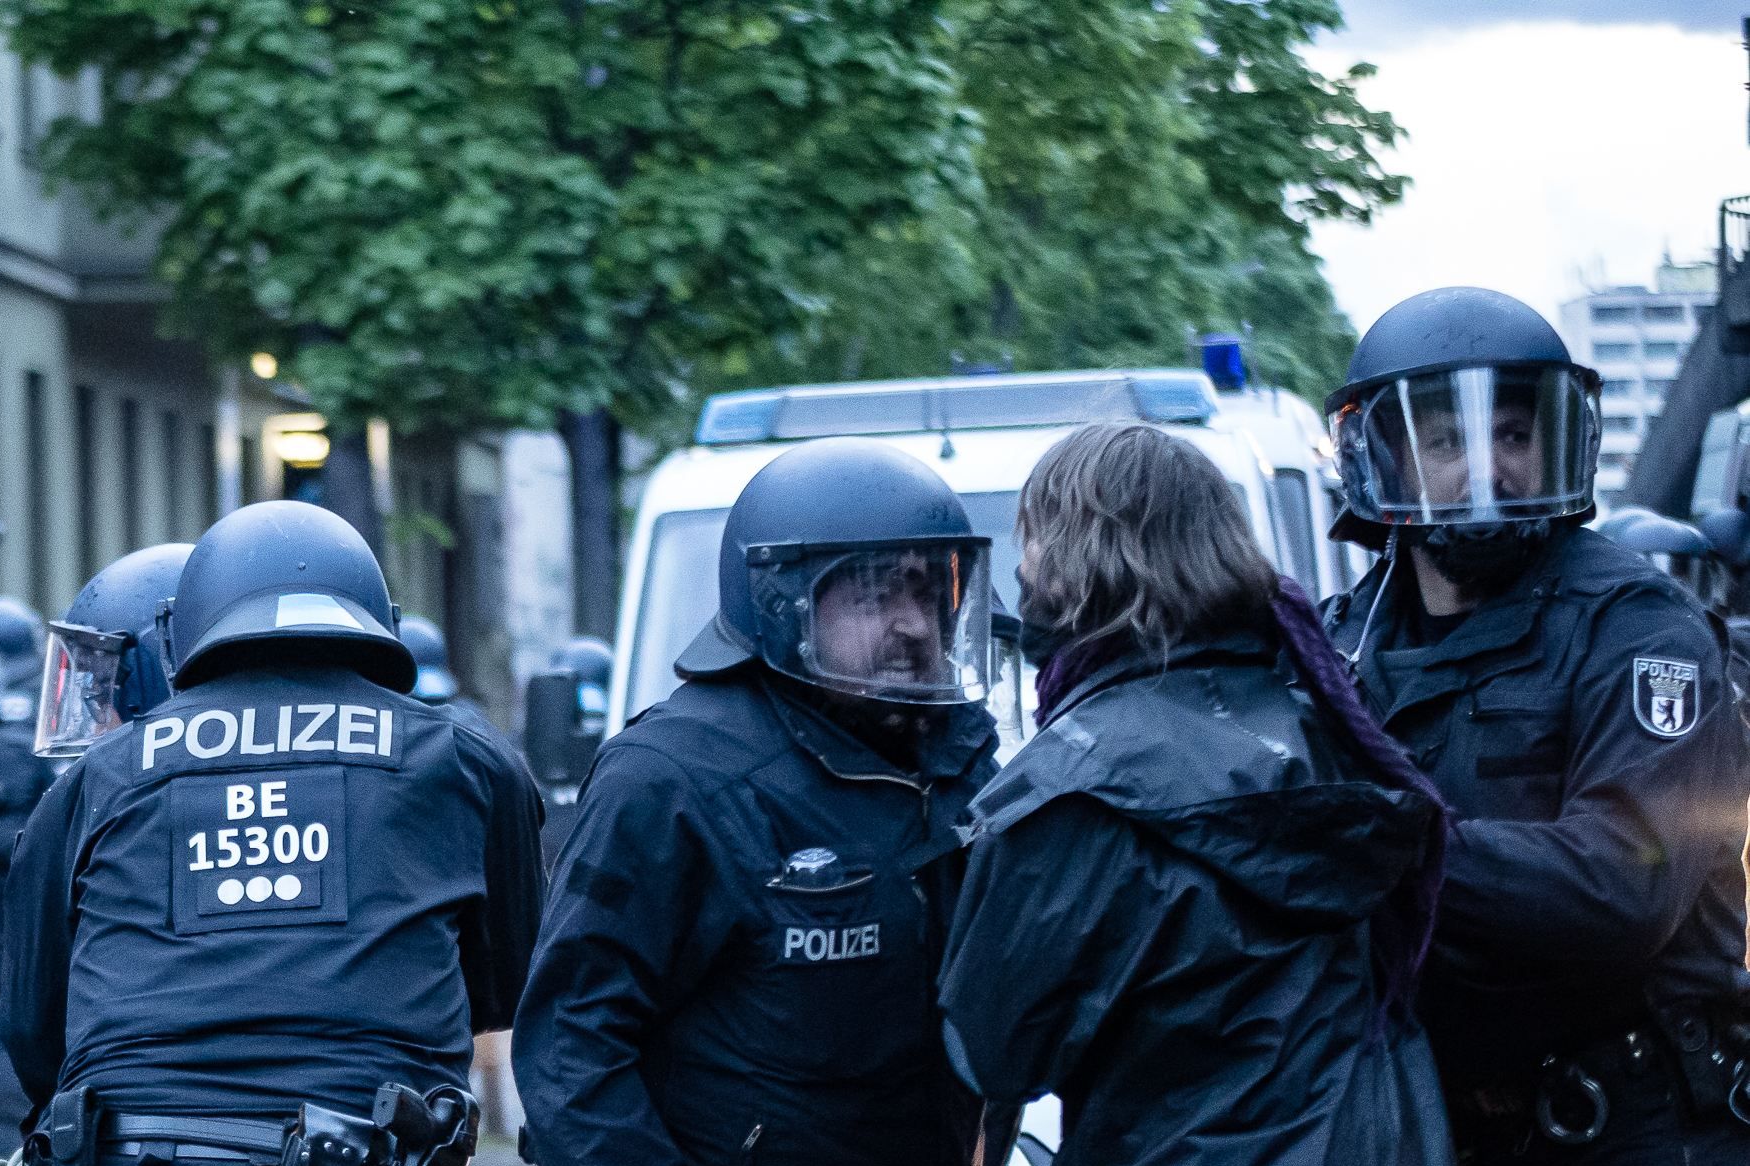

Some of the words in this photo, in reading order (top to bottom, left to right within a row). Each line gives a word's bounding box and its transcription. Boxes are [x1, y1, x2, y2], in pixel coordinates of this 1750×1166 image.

[142, 703, 394, 771] POLIZEI
[226, 781, 289, 821] BE
[187, 822, 329, 872] 15300
[784, 923, 880, 961] POLIZEI
